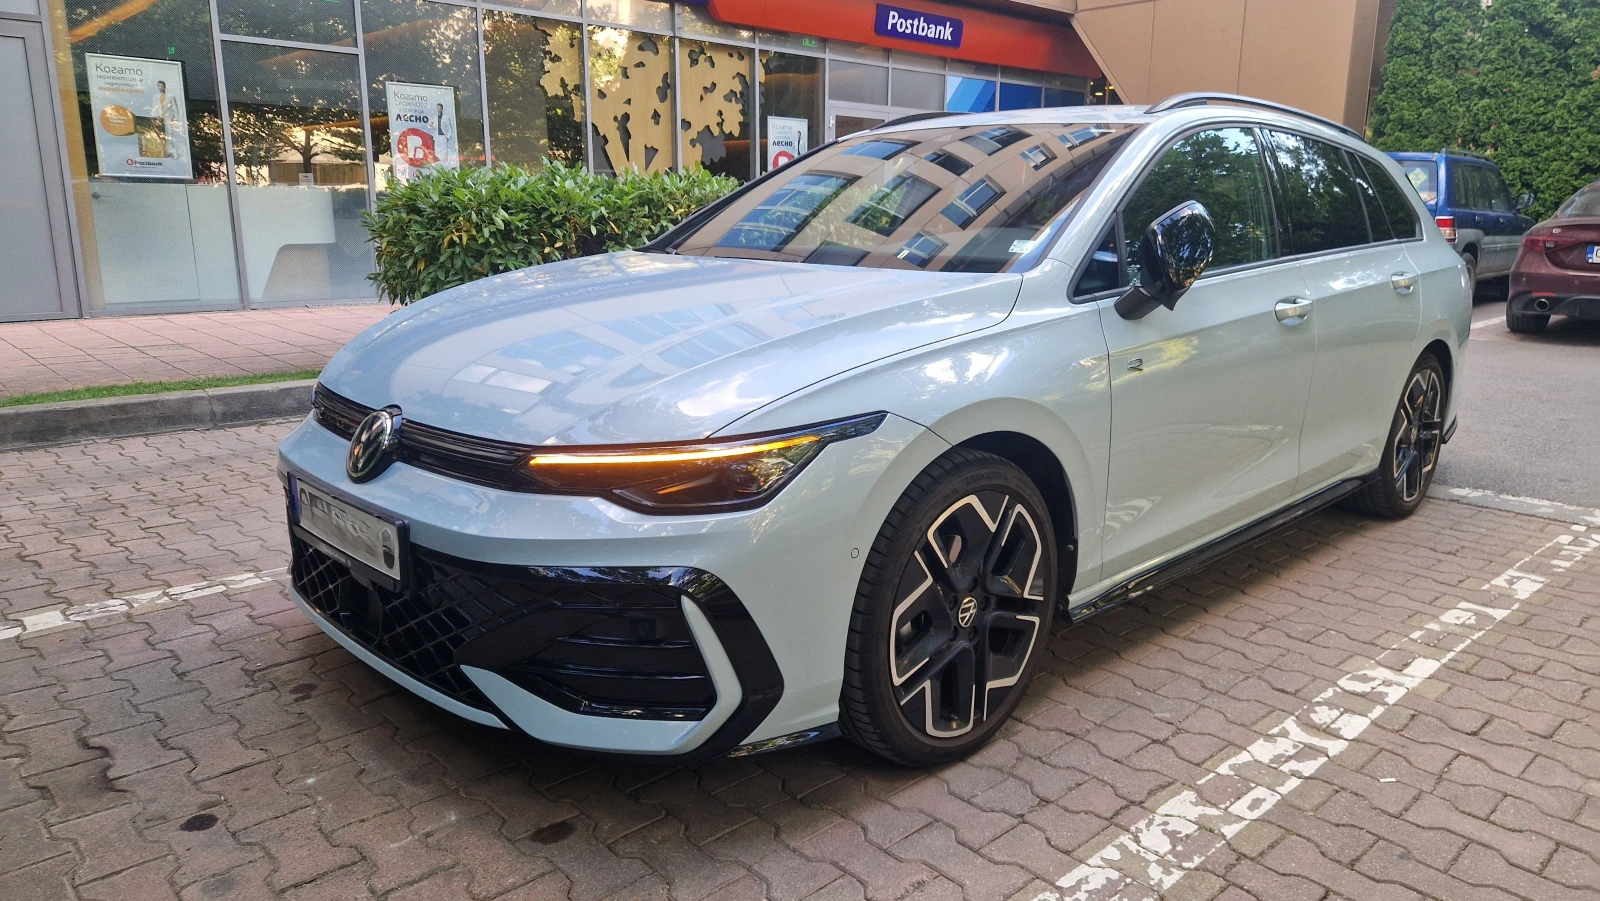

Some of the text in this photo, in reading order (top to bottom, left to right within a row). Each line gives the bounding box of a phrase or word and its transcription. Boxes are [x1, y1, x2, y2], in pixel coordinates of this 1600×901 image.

[887, 10, 953, 41] Postbank
[95, 62, 143, 76] Когато
[394, 91, 428, 102] Когато
[134, 159, 164, 167] Postbank
